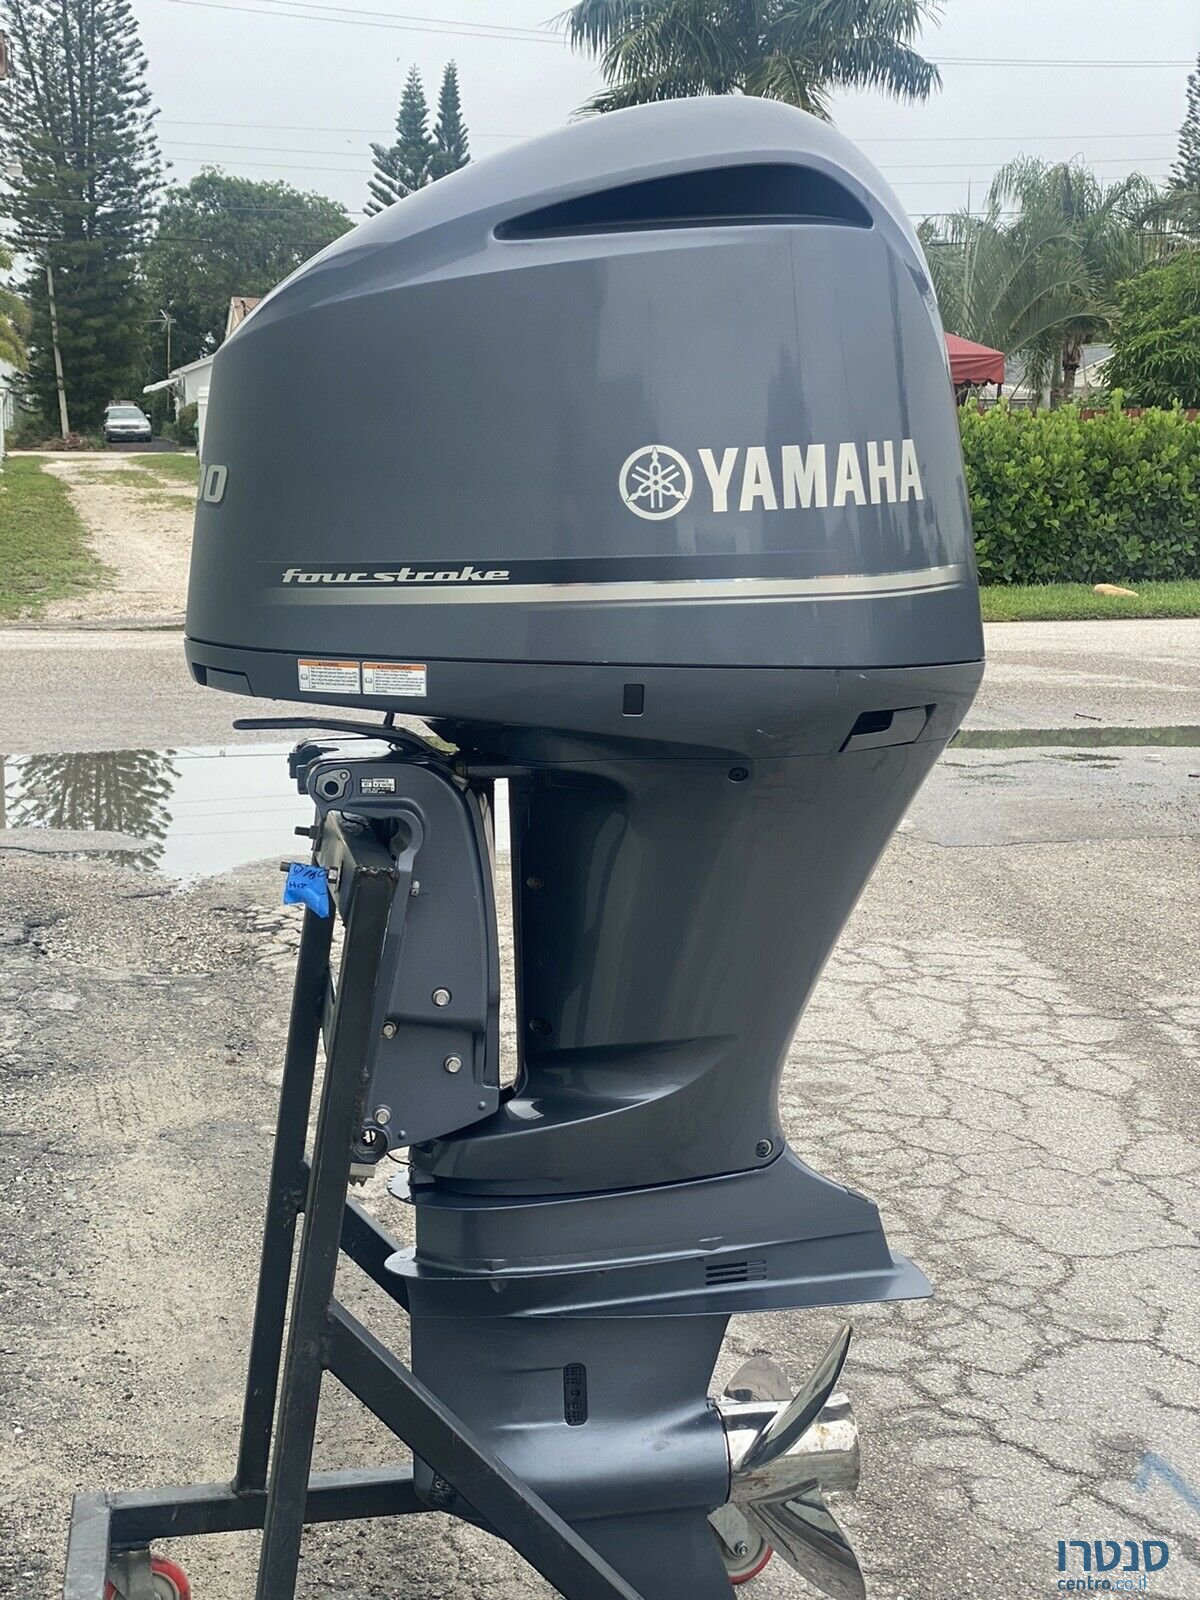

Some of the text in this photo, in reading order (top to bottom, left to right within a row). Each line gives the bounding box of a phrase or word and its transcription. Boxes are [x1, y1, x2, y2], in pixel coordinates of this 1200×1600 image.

[697, 439, 924, 513] YAMAHA
[282, 566, 510, 584] four stroke
